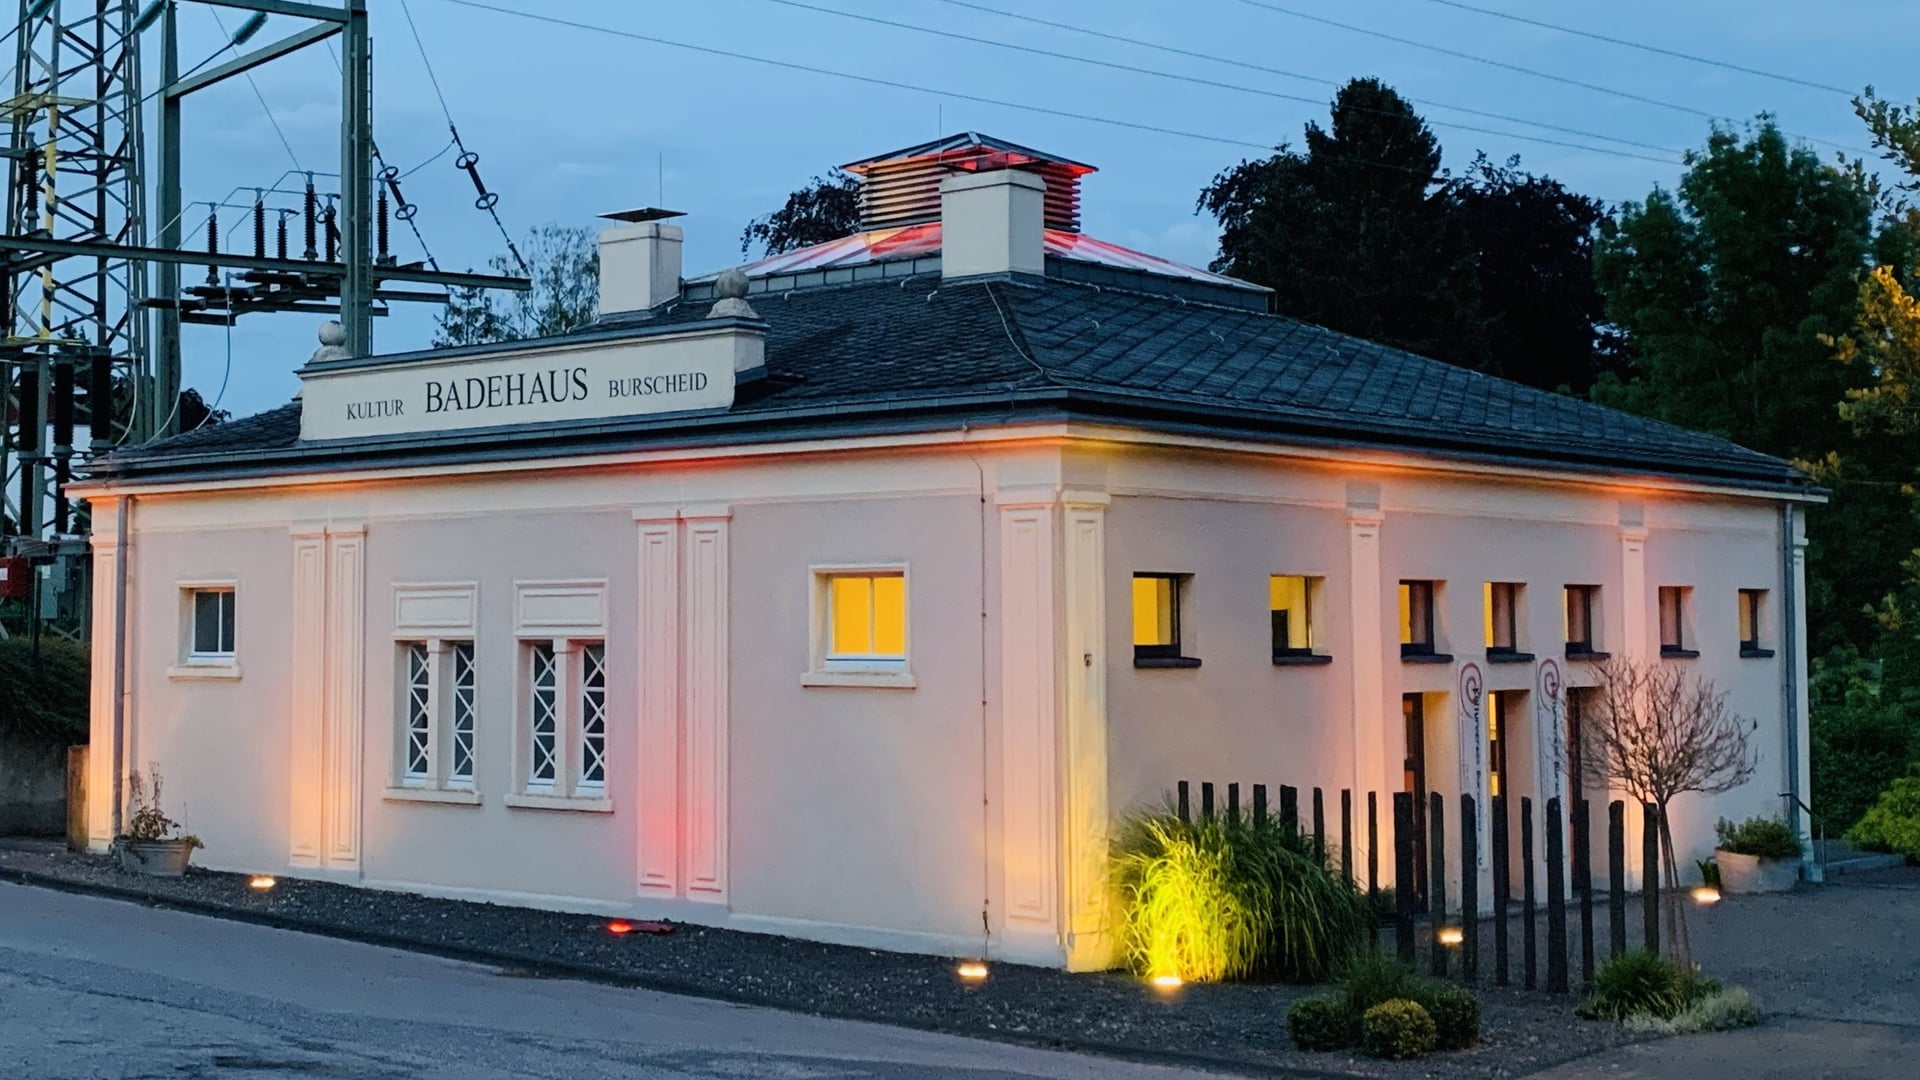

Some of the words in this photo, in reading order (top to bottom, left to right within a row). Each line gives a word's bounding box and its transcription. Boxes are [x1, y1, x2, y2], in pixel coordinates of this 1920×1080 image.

[346, 399, 404, 420] KULTUR
[425, 367, 588, 414] BADEHAUS
[608, 372, 708, 398] BURSCHEID
